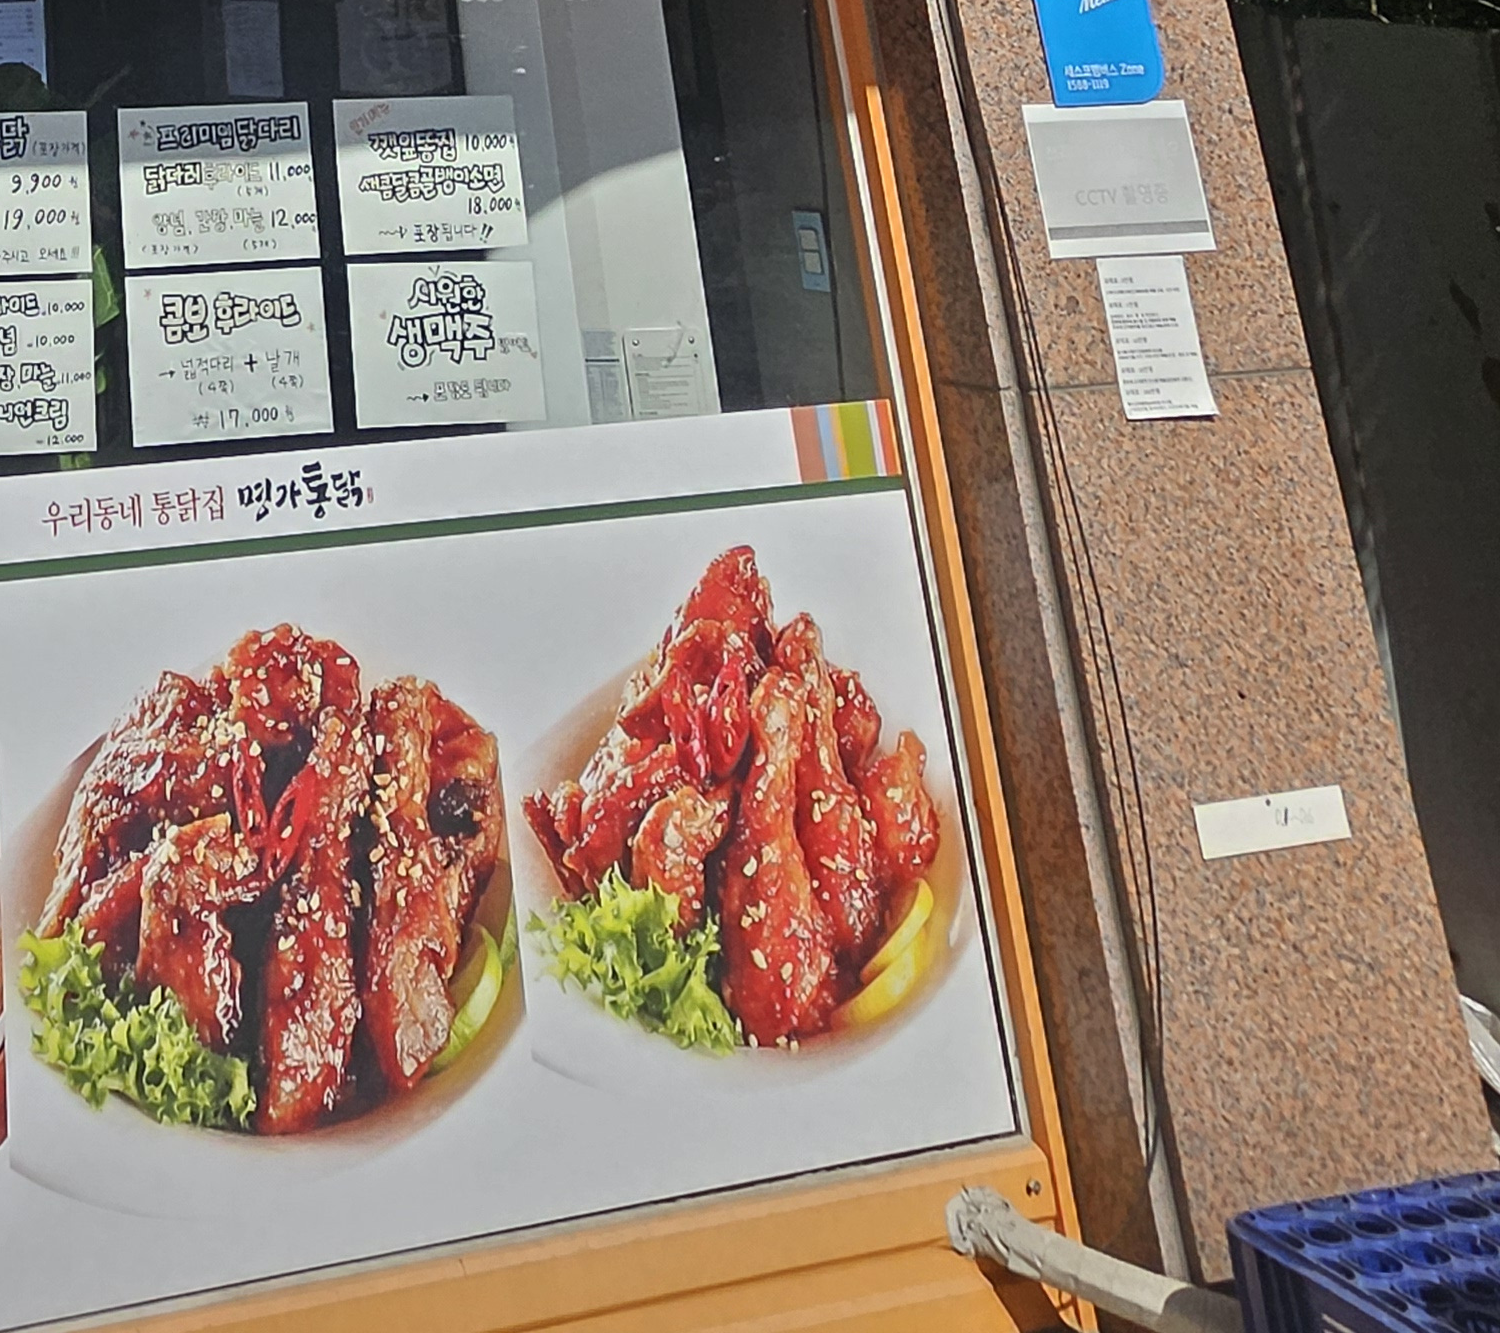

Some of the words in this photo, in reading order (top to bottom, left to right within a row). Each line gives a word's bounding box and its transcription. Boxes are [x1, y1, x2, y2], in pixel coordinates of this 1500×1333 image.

[1075, 188, 1118, 207] CCTV
[407, 274, 486, 314] 시원한
[159, 293, 210, 345] 콤보
[213, 291, 302, 335] 후라이드
[386, 313, 496, 368] 생맥주
[265, 348, 300, 374] 날개
[41, 491, 144, 538] 우리동네
[151, 484, 227, 526] 통닭집
[236, 461, 364, 523] 명가통닭
